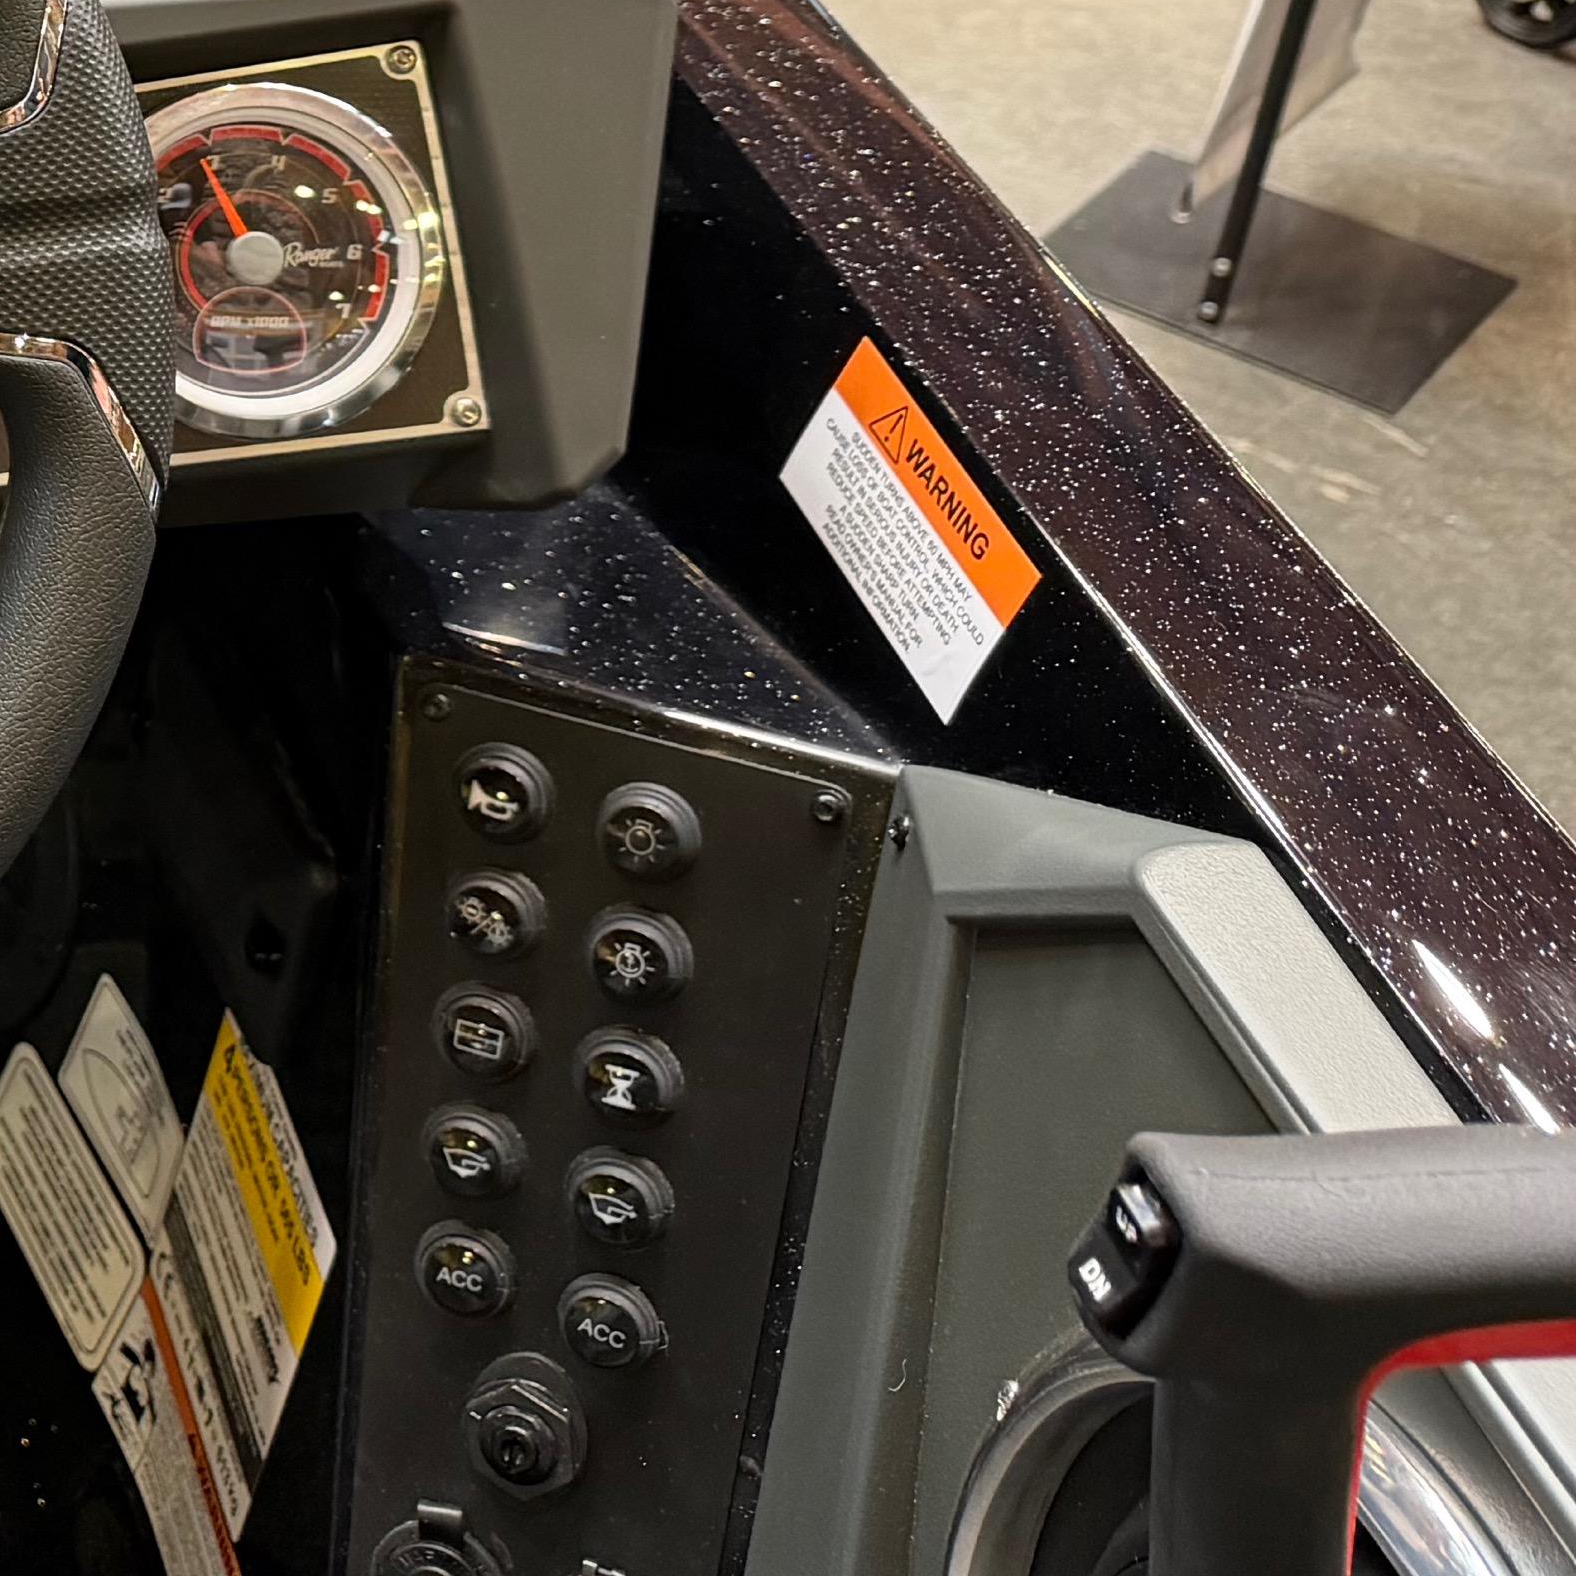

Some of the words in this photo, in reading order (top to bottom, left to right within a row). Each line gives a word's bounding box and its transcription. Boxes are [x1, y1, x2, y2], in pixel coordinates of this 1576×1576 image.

[270, 155, 286, 171] 4
[321, 188, 339, 204] 5
[283, 242, 339, 268] Ranger
[345, 244, 363, 261] 6
[335, 303, 350, 319] 7
[903, 438, 992, 564] WARNING
[894, 539, 922, 580] INJURY
[920, 576, 934, 597] OR
[935, 551, 955, 580] MPH
[952, 575, 972, 604] MAY
[903, 575, 952, 646] ATTEMPTING
[930, 568, 958, 609] WHICH
[955, 603, 984, 647] COULD
[435, 1265, 483, 1293] ACC
[1078, 1257, 1112, 1303] DN
[577, 1318, 627, 1351] ACC
